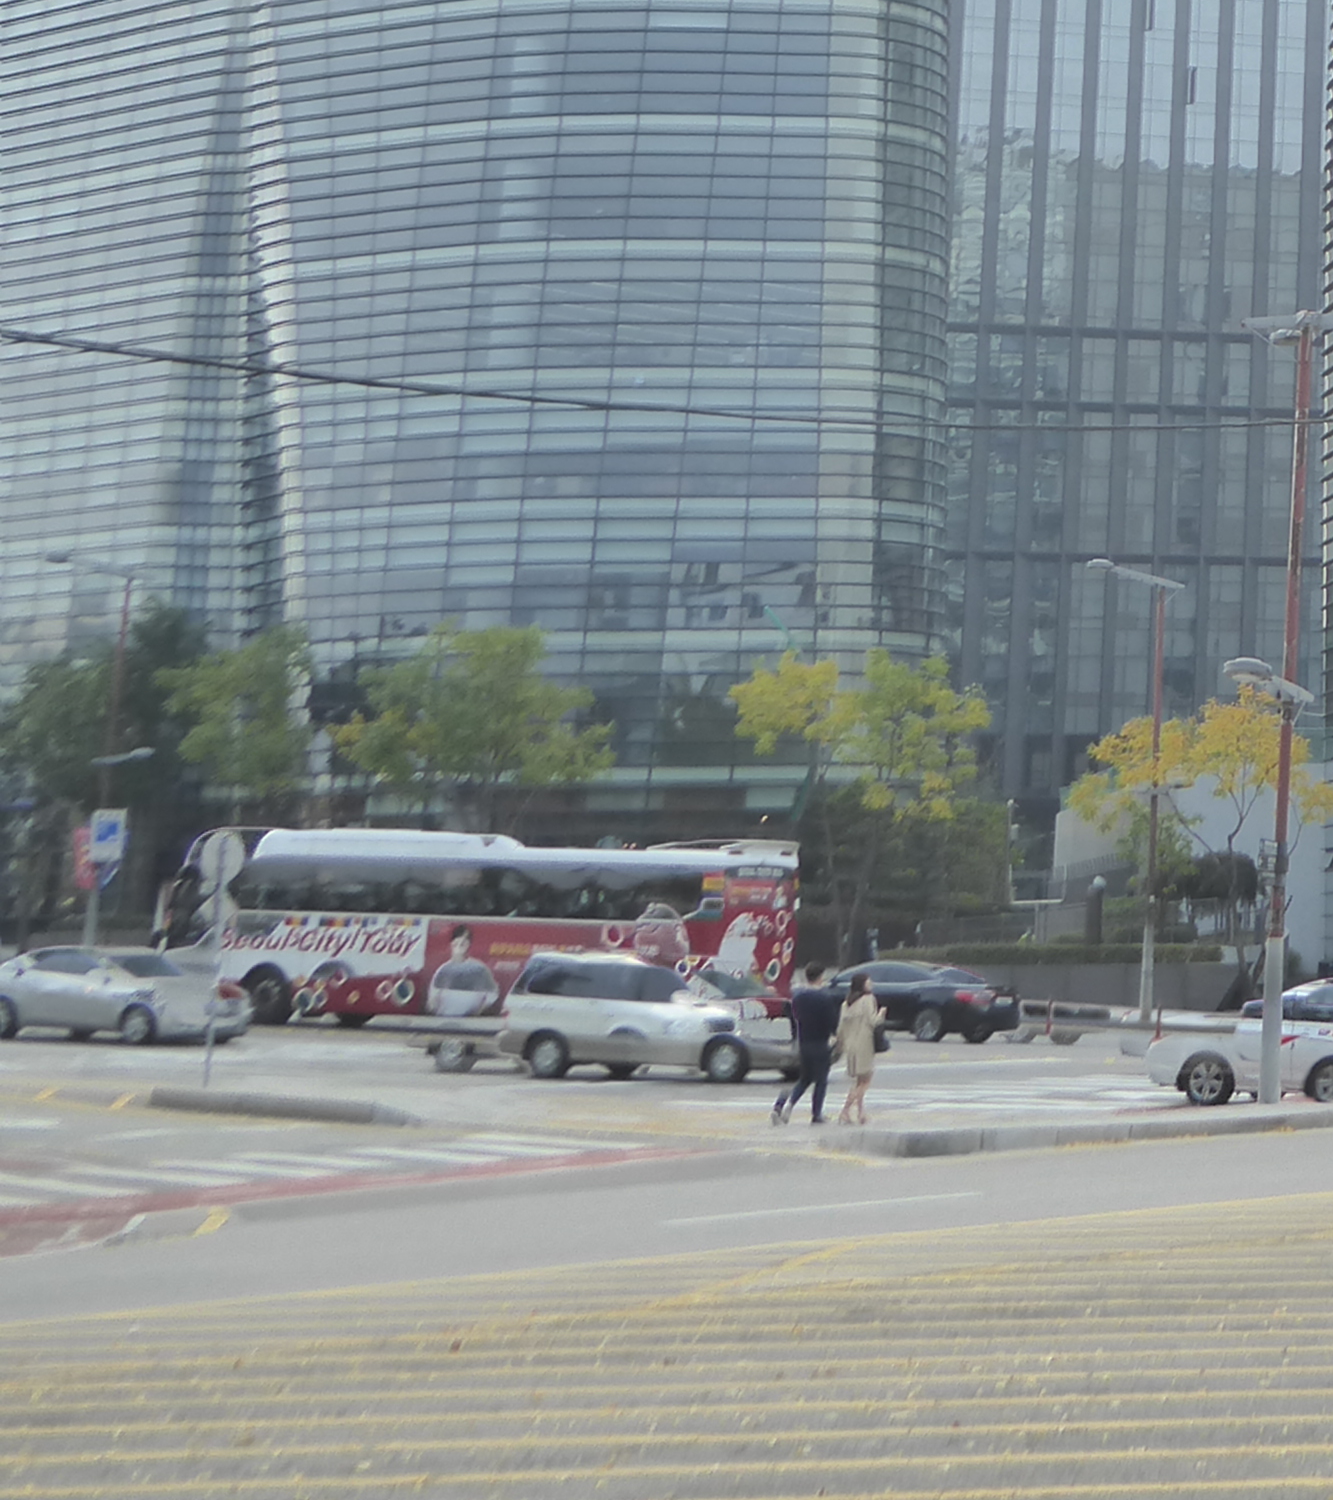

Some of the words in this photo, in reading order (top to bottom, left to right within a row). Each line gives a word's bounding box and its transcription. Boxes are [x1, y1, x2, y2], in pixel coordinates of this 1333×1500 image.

[221, 927, 296, 950] Seoul
[299, 926, 352, 958] City
[360, 927, 421, 957] Tour
